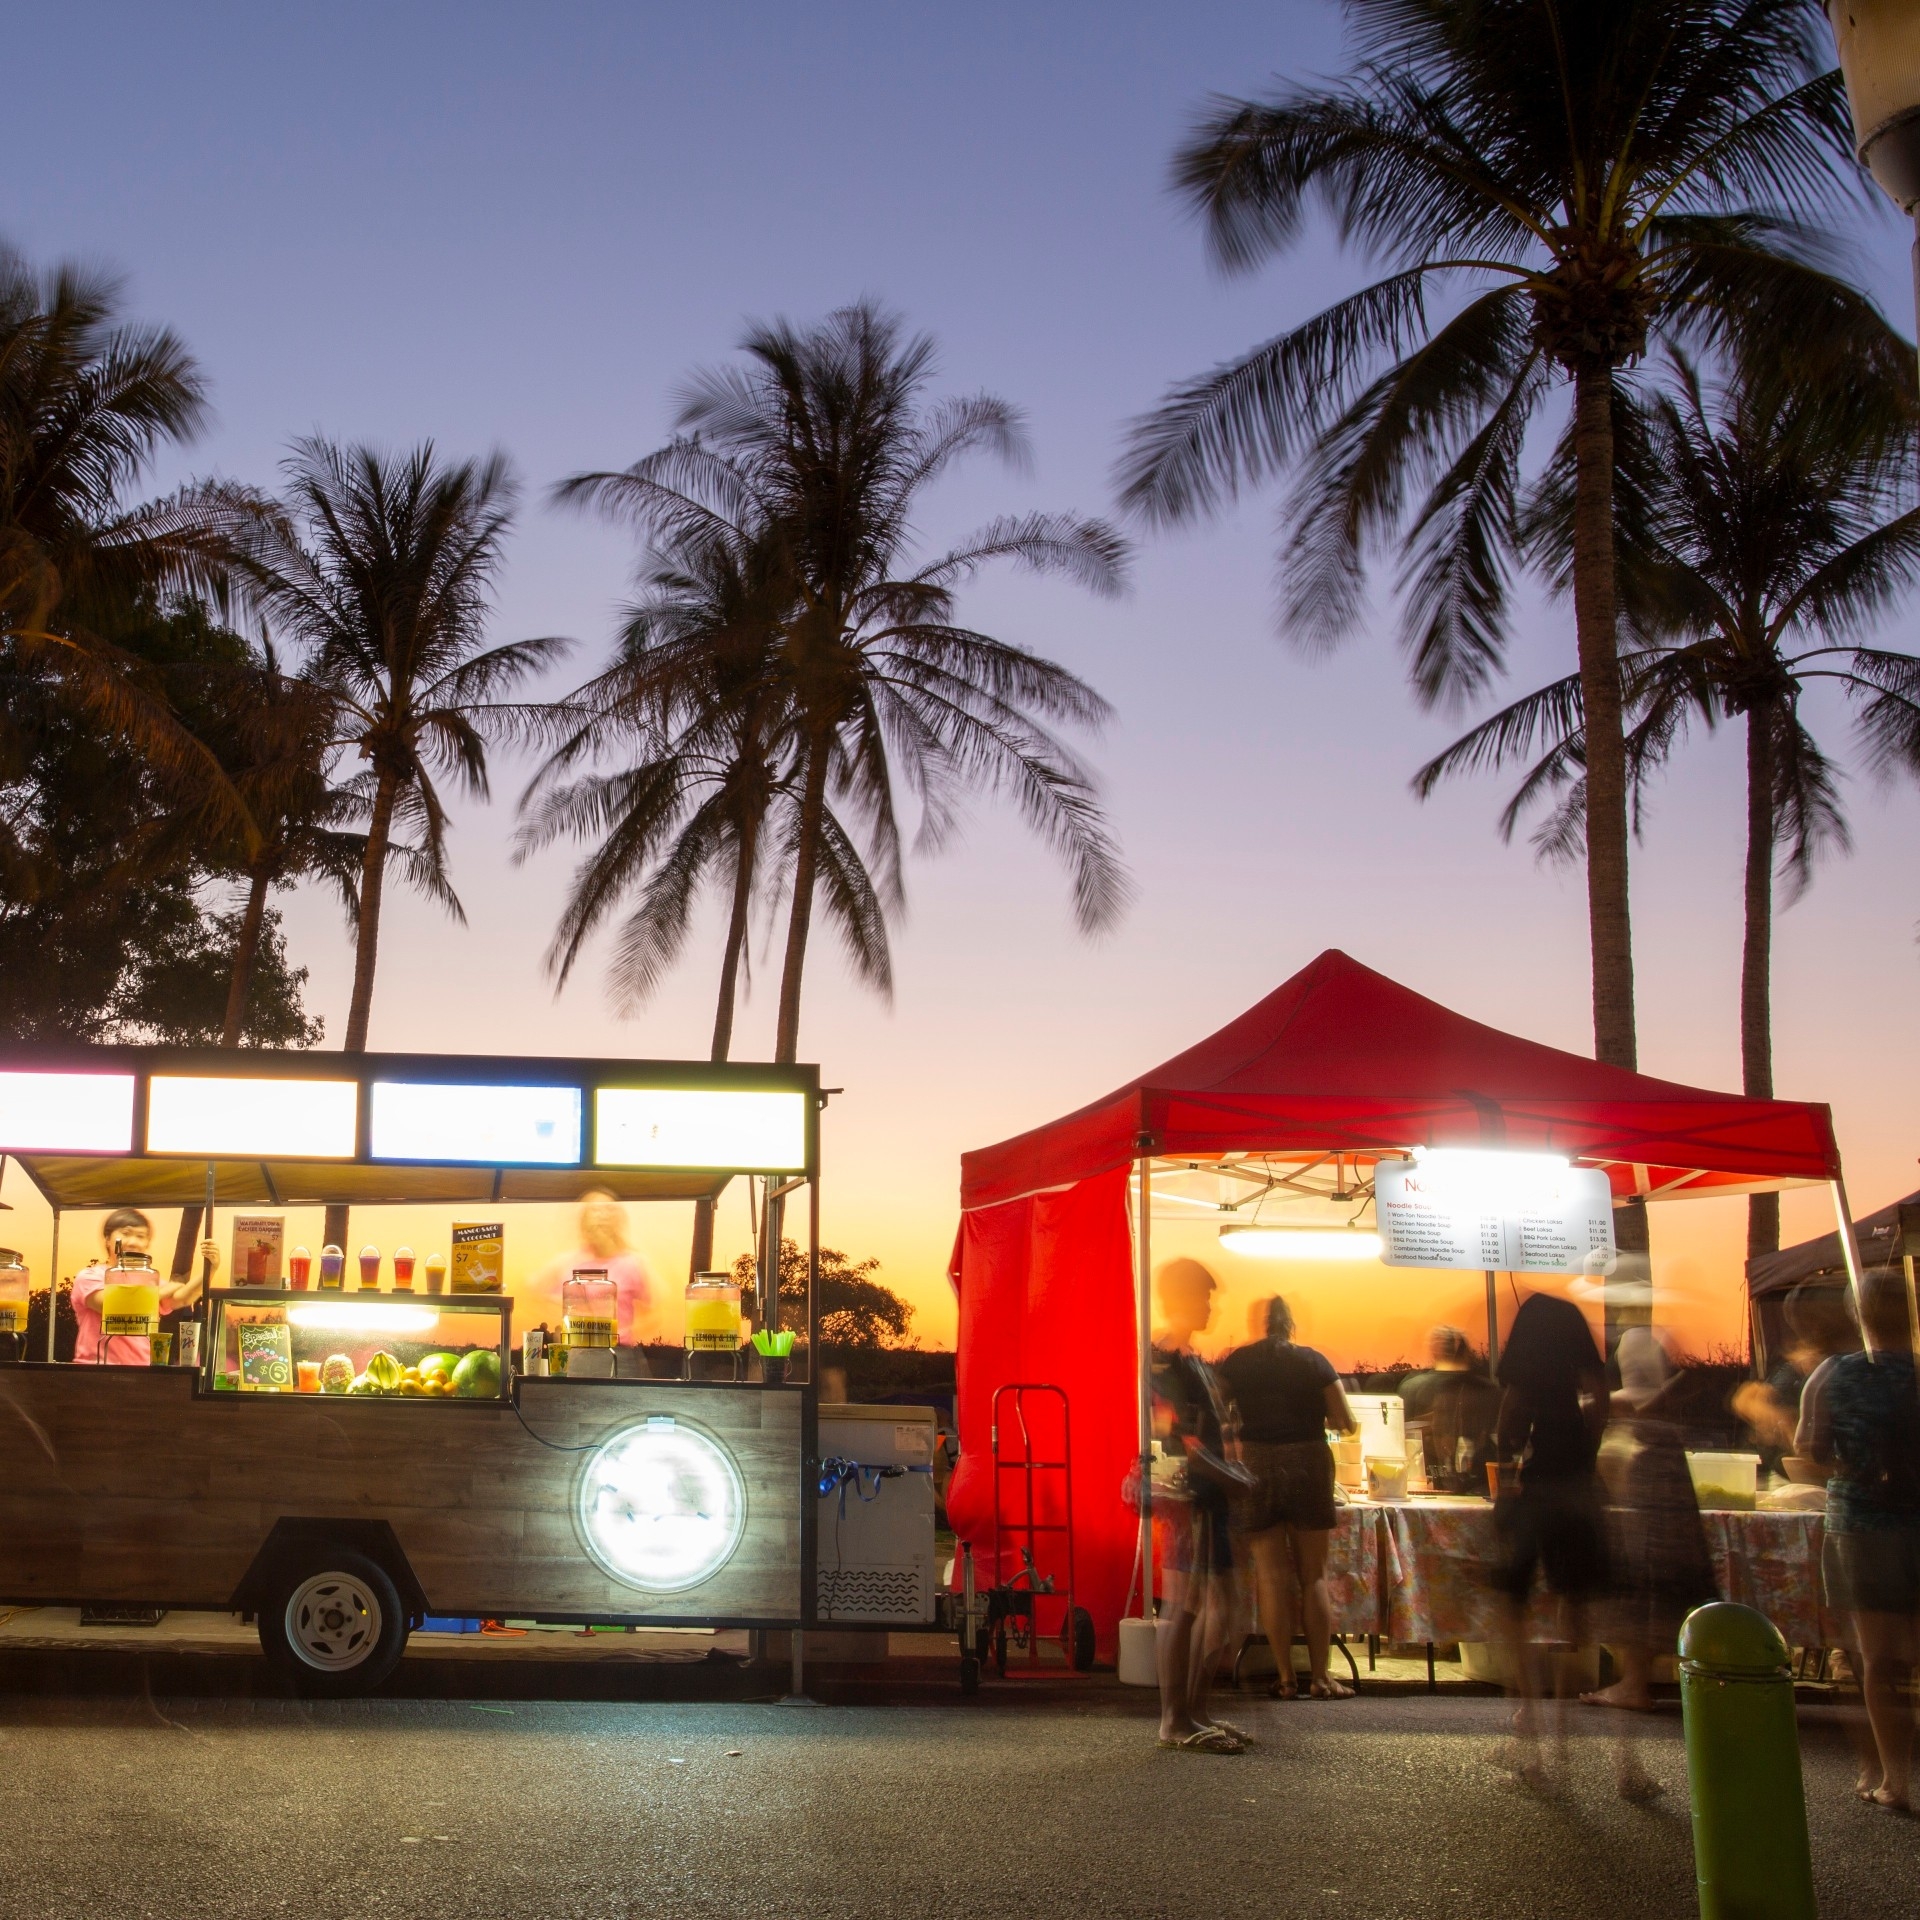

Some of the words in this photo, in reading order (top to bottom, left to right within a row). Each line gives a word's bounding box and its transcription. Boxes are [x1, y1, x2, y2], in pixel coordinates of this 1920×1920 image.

[1386, 1201, 1412, 1210] Noodle
[1414, 1203, 1432, 1211] Soup
[1437, 1222, 1453, 1230] Soup
[466, 1233, 496, 1241] COCONUT
[1524, 1242, 1560, 1250] Combination
[1451, 1247, 1466, 1255] Soup
[1524, 1250, 1548, 1258] Seafood
[455, 1252, 469, 1263] $7
[105, 1315, 126, 1324] LEMON
[127, 1316, 134, 1324] &
[135, 1316, 150, 1324] LIME
[587, 1321, 612, 1331] ORANGE
[695, 1333, 716, 1342] LEMON
[718, 1333, 724, 1342] &
[260, 1361, 288, 1384] $6
